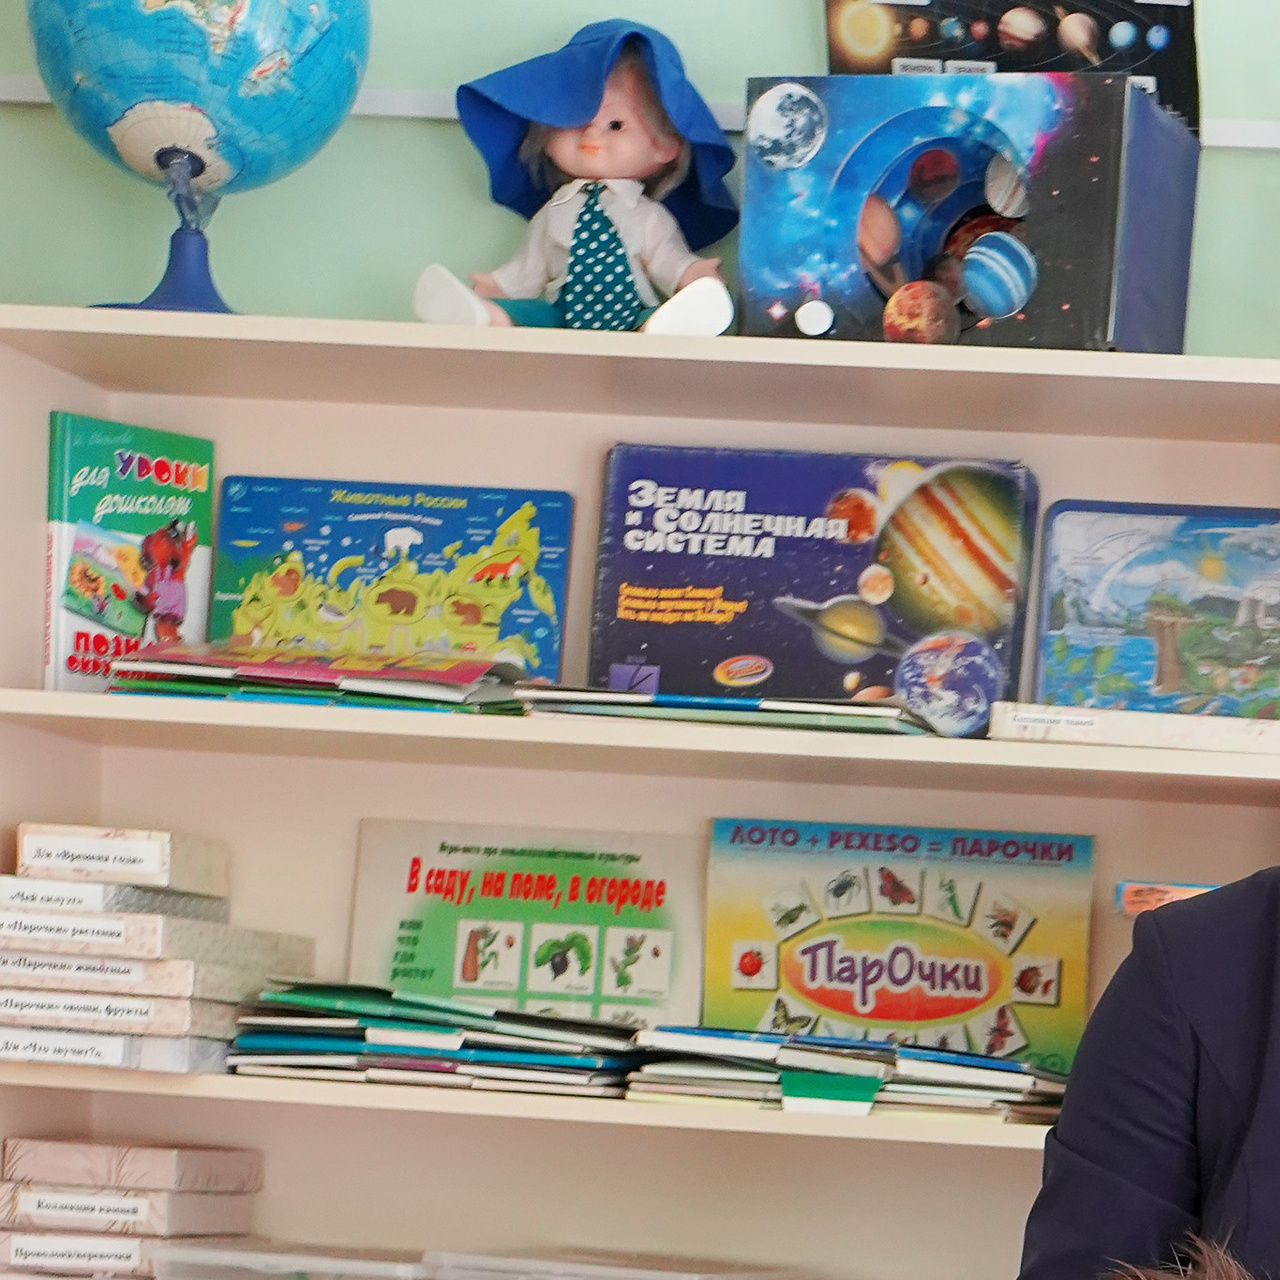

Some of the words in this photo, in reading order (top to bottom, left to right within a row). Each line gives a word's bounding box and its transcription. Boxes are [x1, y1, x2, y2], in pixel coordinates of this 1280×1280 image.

[70, 465, 110, 497] для
[114, 449, 209, 493] УРОКИ
[93, 492, 193, 524] дошколят
[627, 479, 747, 512] ЗЕМЛЯ
[652, 508, 849, 540] СОЛНЕЧНАЯ
[623, 528, 776, 558] СИСТЕМА
[730, 825, 799, 847] ЛОТО
[951, 837, 1075, 863] ПАРОЧКИ
[406, 856, 422, 894] В
[425, 867, 475, 906] саду,
[479, 871, 506, 897] на
[508, 871, 563, 910] поле,
[567, 874, 583, 904] в
[585, 876, 667, 916] огороде
[801, 938, 983, 1008] ПарОчки
